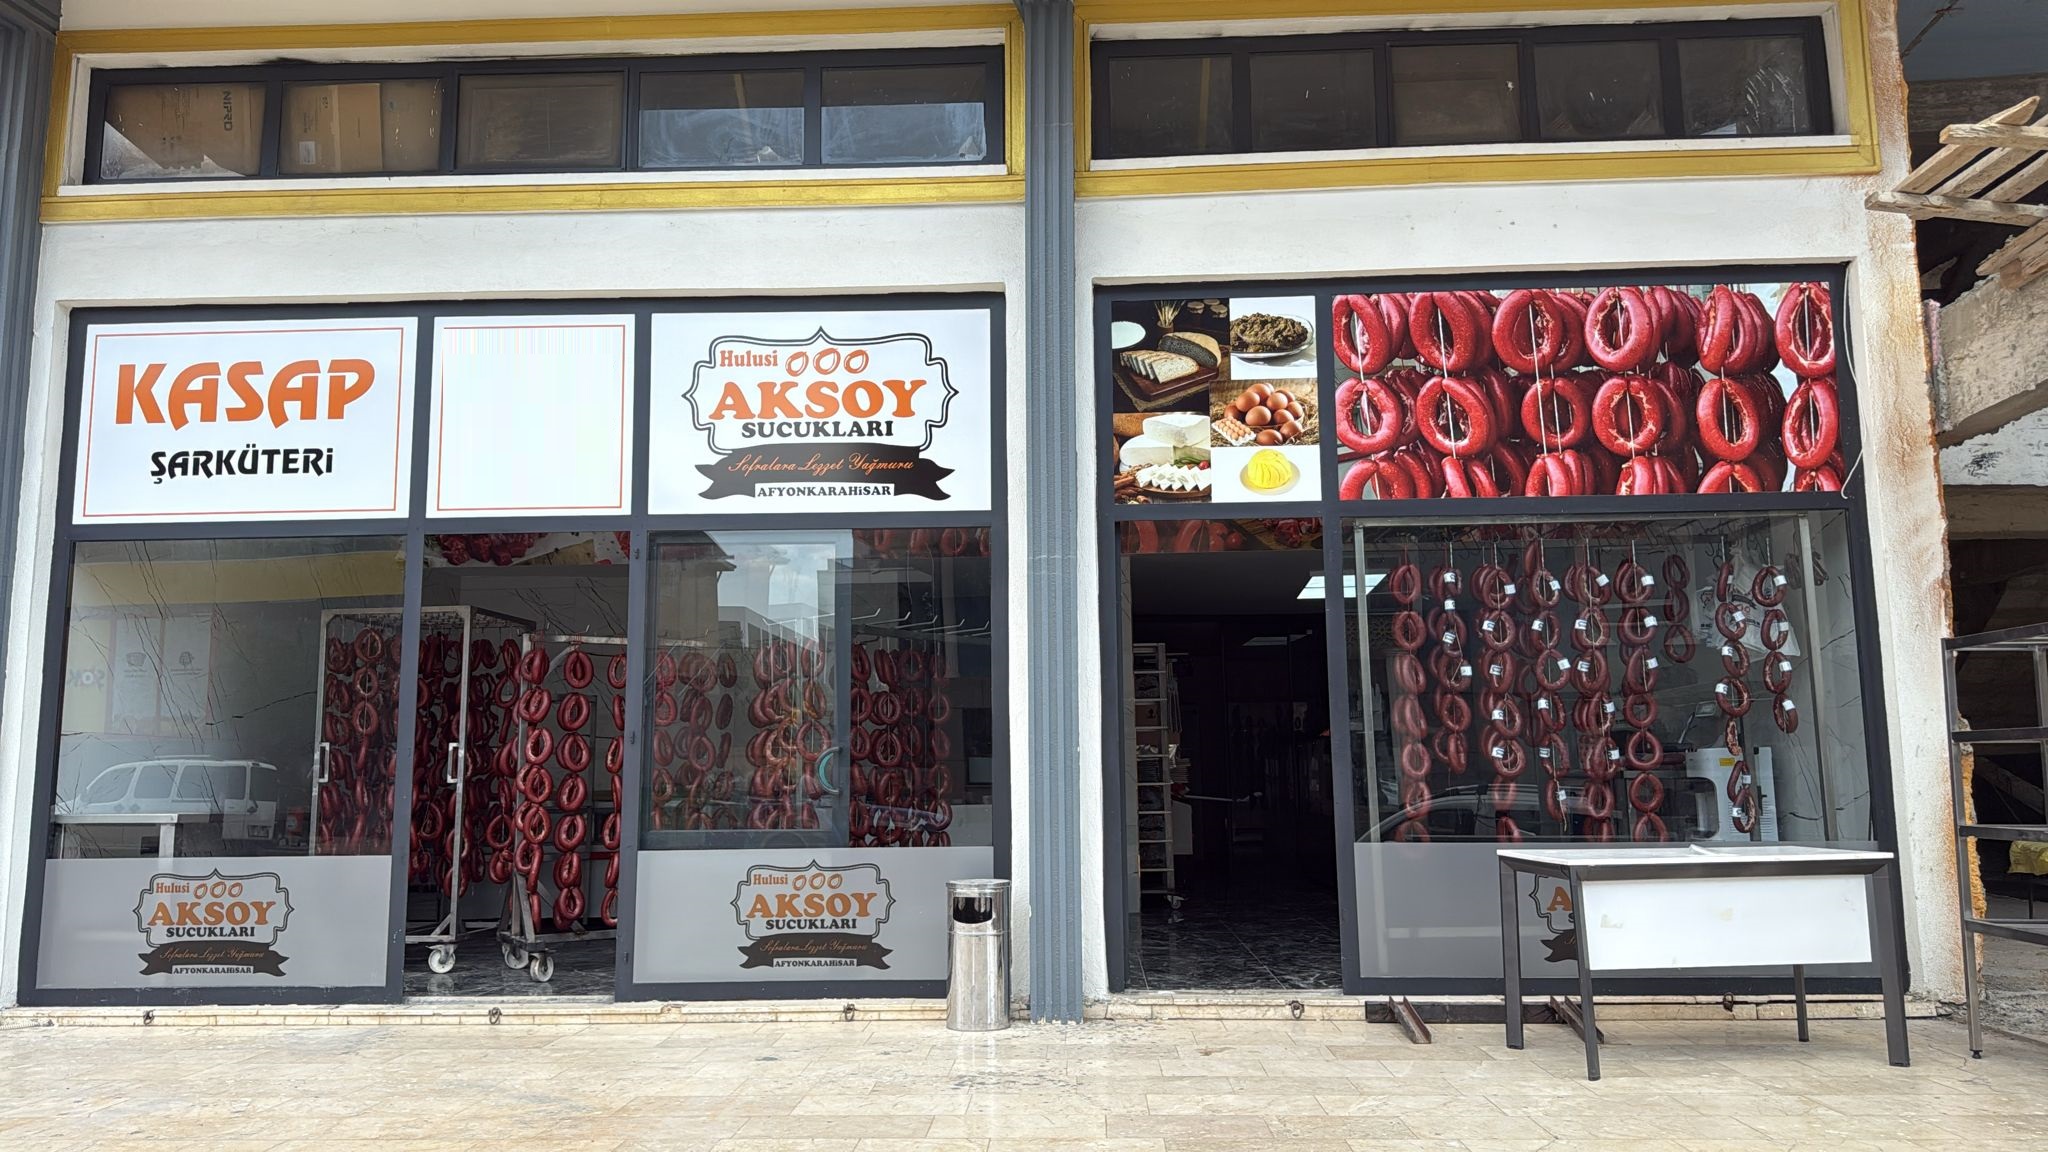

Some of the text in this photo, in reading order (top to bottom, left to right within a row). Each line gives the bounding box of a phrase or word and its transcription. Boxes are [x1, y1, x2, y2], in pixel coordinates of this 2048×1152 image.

[719, 350, 778, 367] Hulusi
[115, 358, 375, 431] KASAP
[708, 379, 927, 420] AKSOY
[741, 420, 894, 438] SUCUKLARI
[727, 452, 914, 477] Sofralara Lezzet Yağmuru
[155, 882, 190, 894] Hulusi
[753, 874, 789, 886] Hulusi
[147, 901, 277, 926] AKSOY
[746, 893, 878, 918] AKSOY
[165, 926, 256, 938] SUCUKLARI
[765, 918, 857, 930] SUCUKLARI
